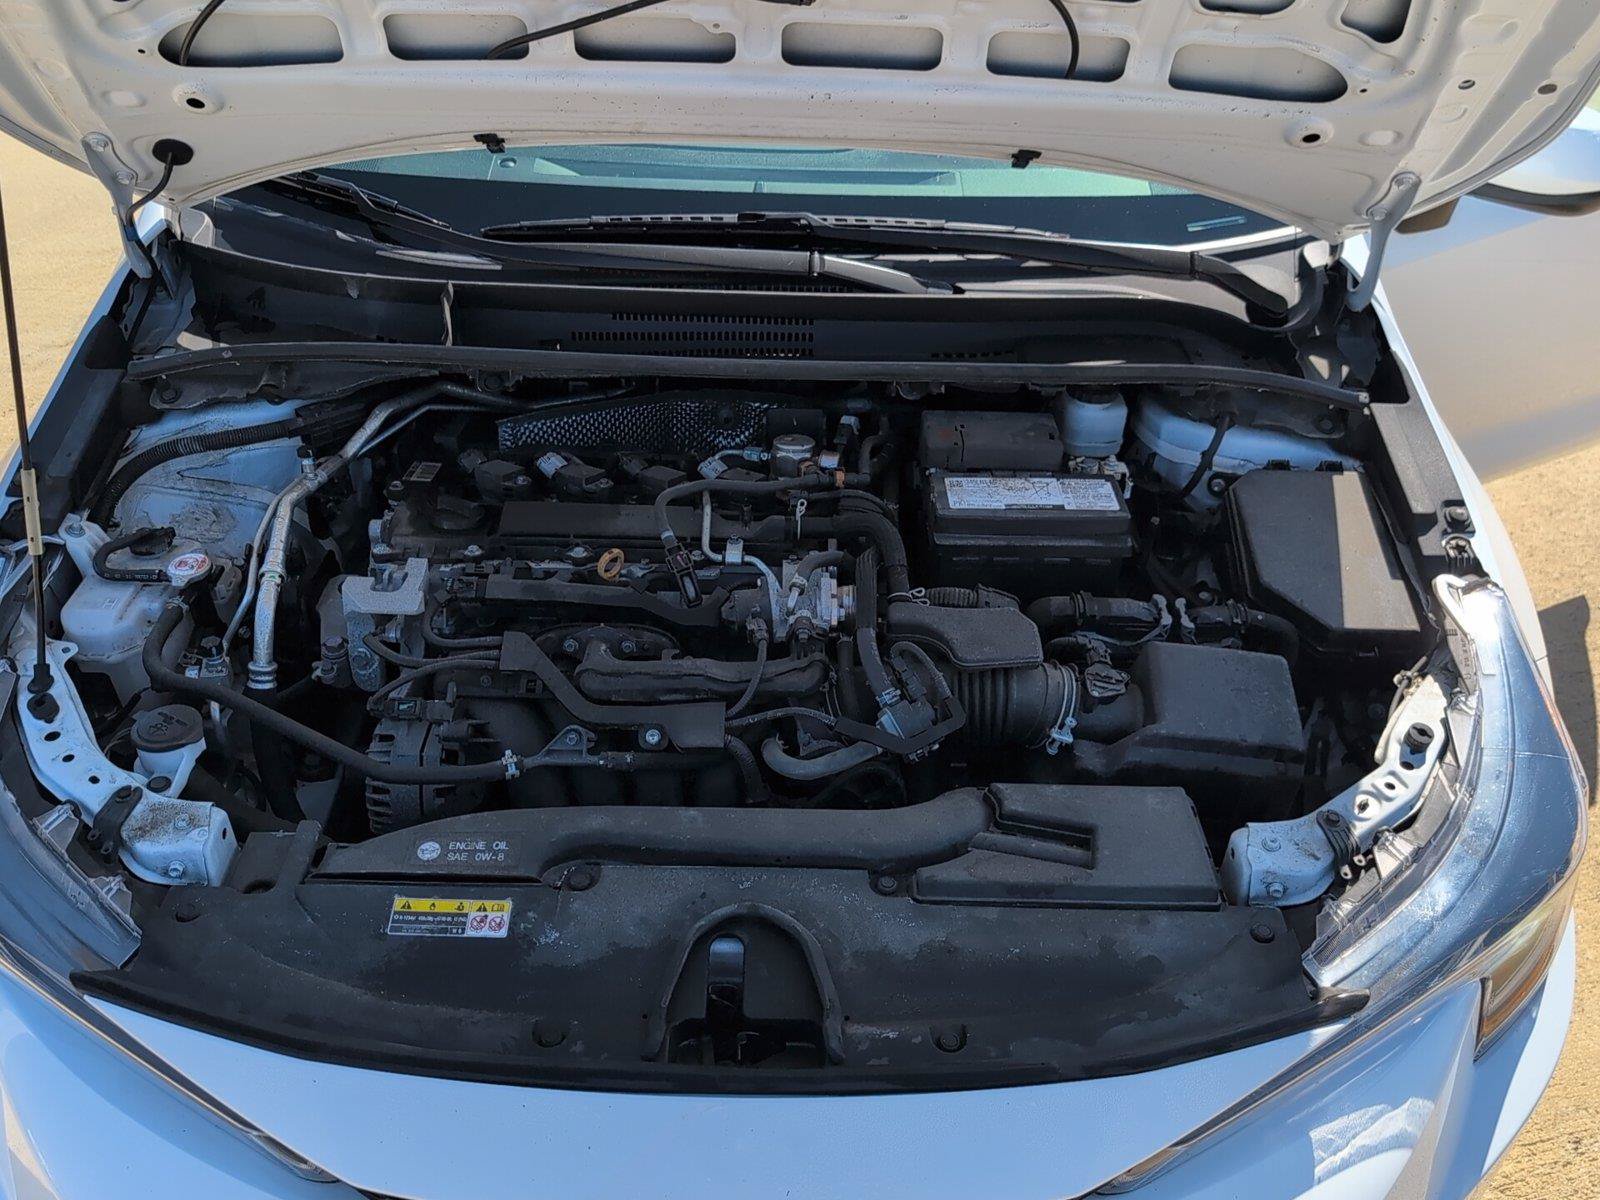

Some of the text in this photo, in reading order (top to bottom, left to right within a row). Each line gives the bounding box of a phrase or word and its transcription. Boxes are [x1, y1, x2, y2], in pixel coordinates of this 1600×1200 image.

[448, 841, 510, 850] ENGINE OIL
[446, 852, 505, 861] SAE 0W-8
